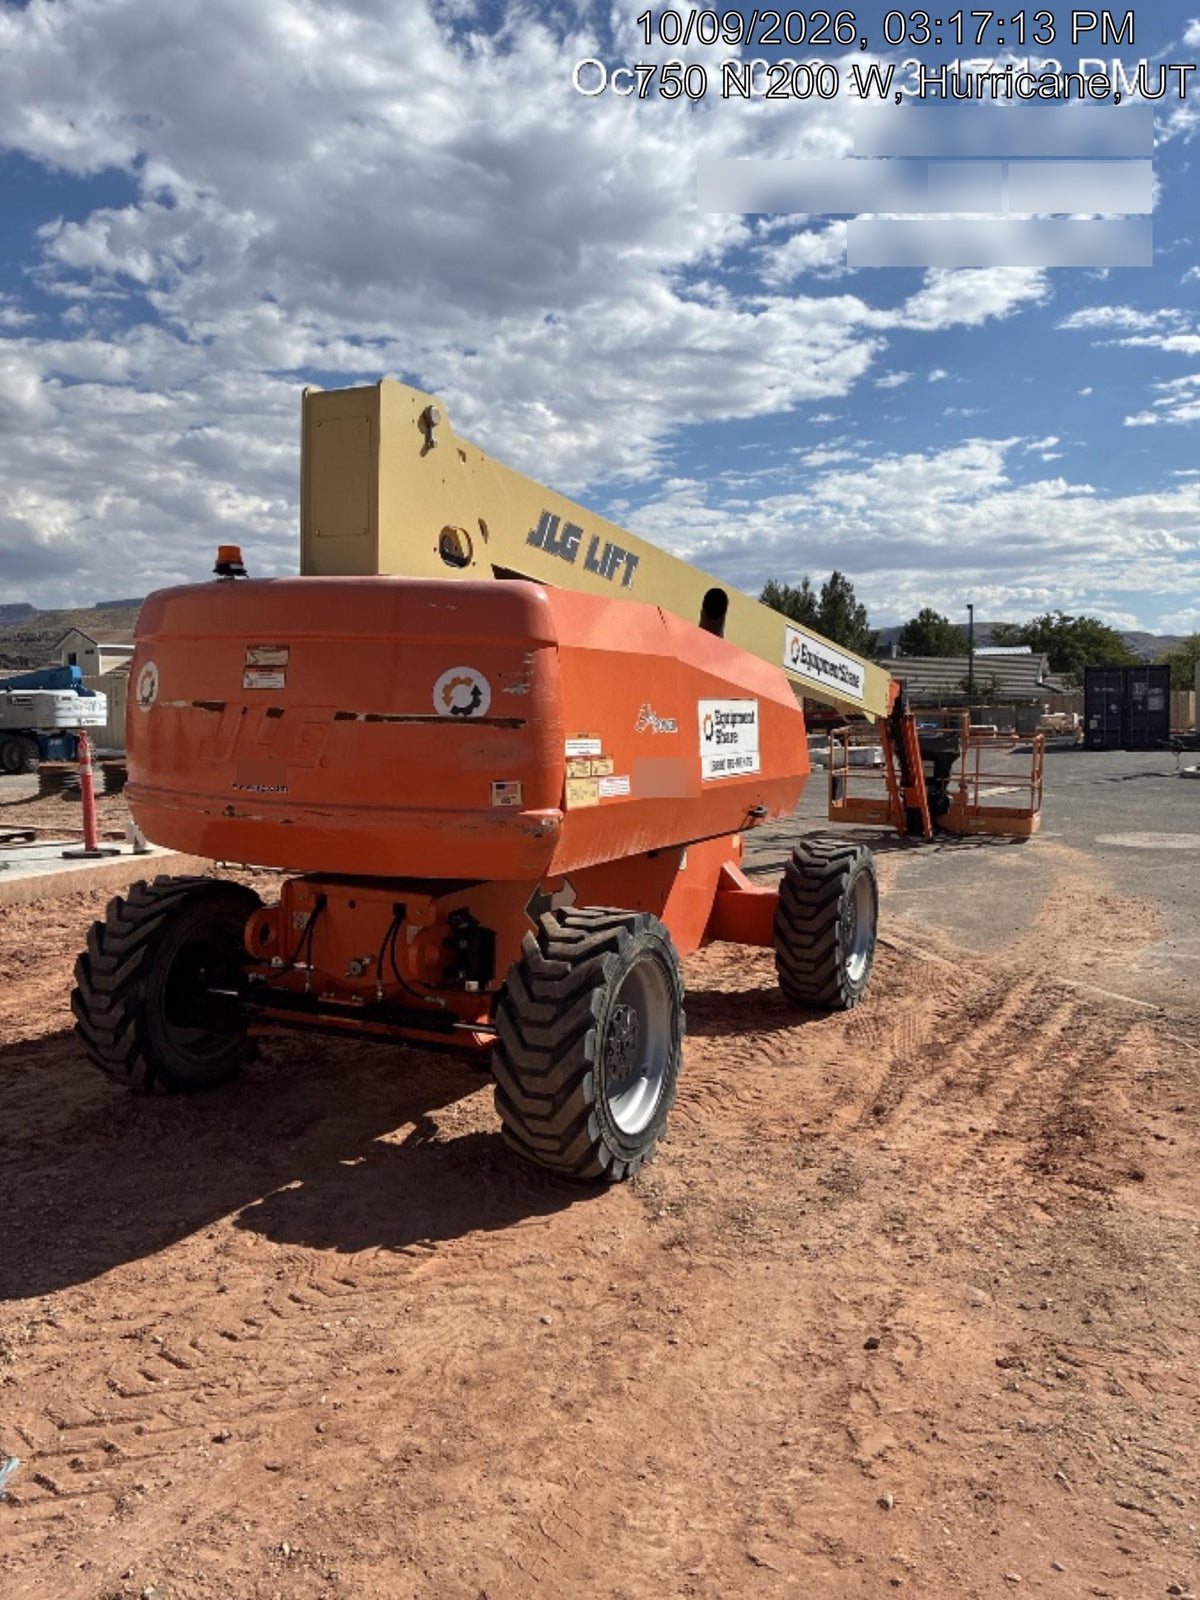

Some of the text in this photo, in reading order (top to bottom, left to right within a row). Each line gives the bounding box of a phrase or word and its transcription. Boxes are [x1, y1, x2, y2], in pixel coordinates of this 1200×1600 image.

[525, 508, 640, 591] JLG LIFT
[714, 709, 755, 728] Equipment
[715, 728, 739, 745] Share
